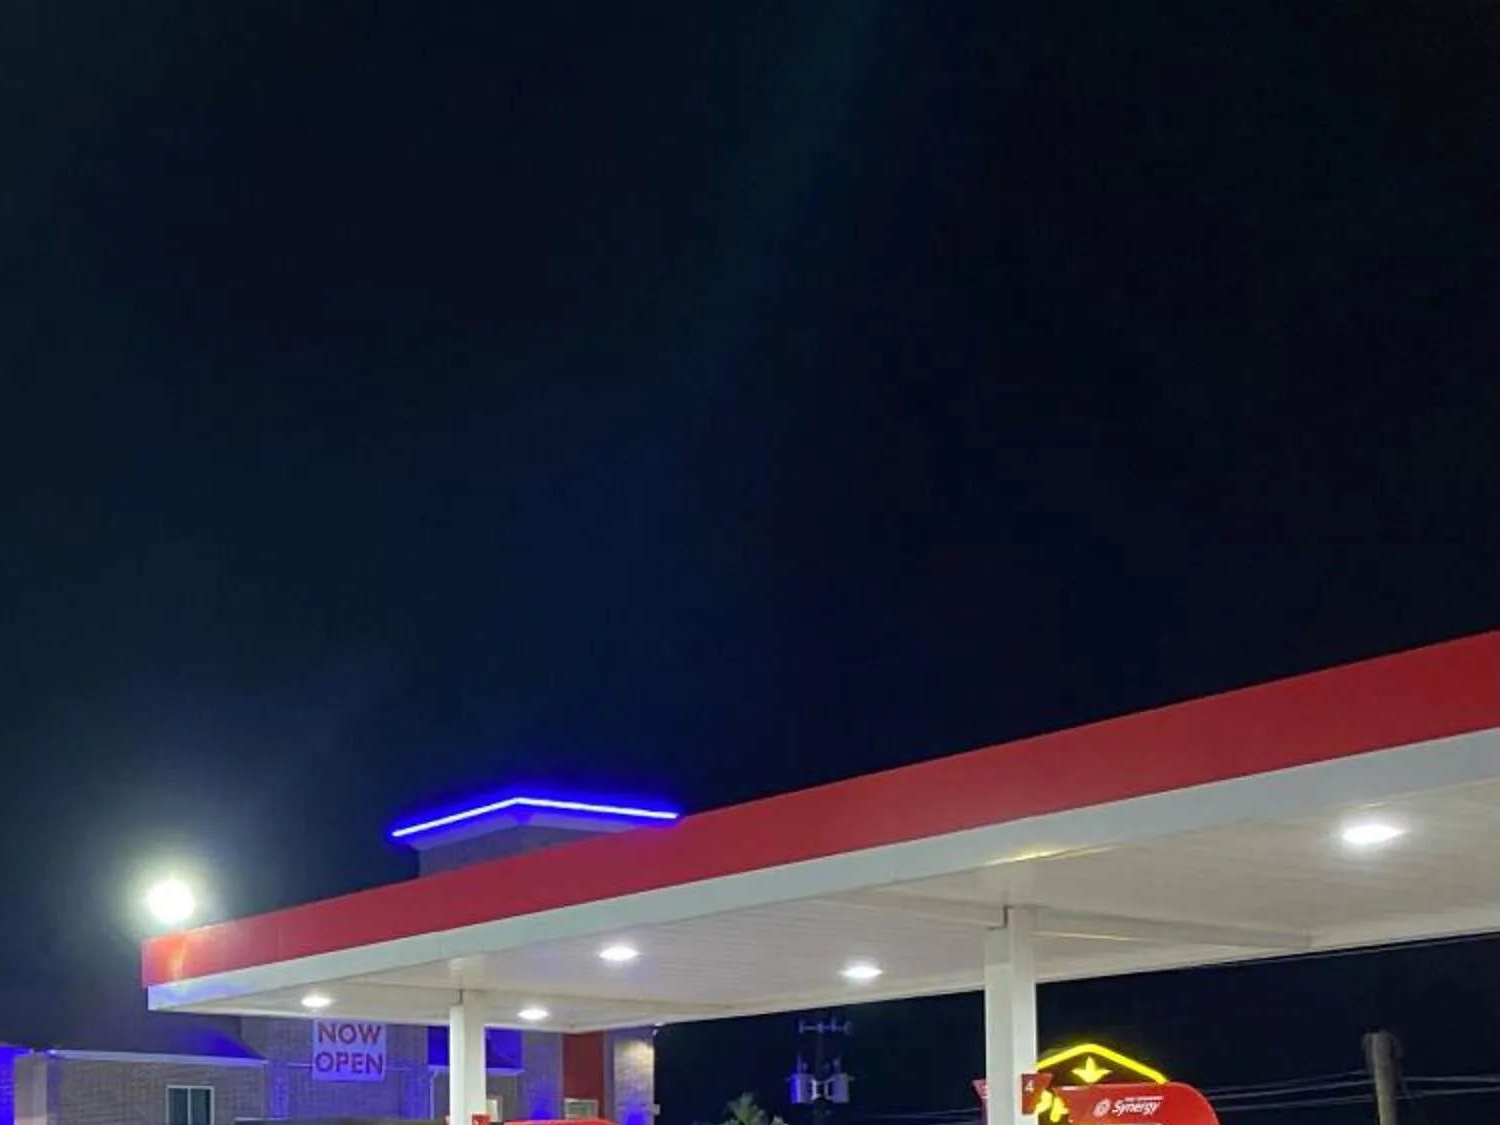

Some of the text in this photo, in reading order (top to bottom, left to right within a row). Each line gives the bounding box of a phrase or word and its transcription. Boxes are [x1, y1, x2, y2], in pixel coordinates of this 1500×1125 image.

[318, 1022, 381, 1045] NOW
[316, 1051, 383, 1074] OPEN
[1025, 1080, 1034, 1093] 4
[1111, 1100, 1161, 1116] Synergy
